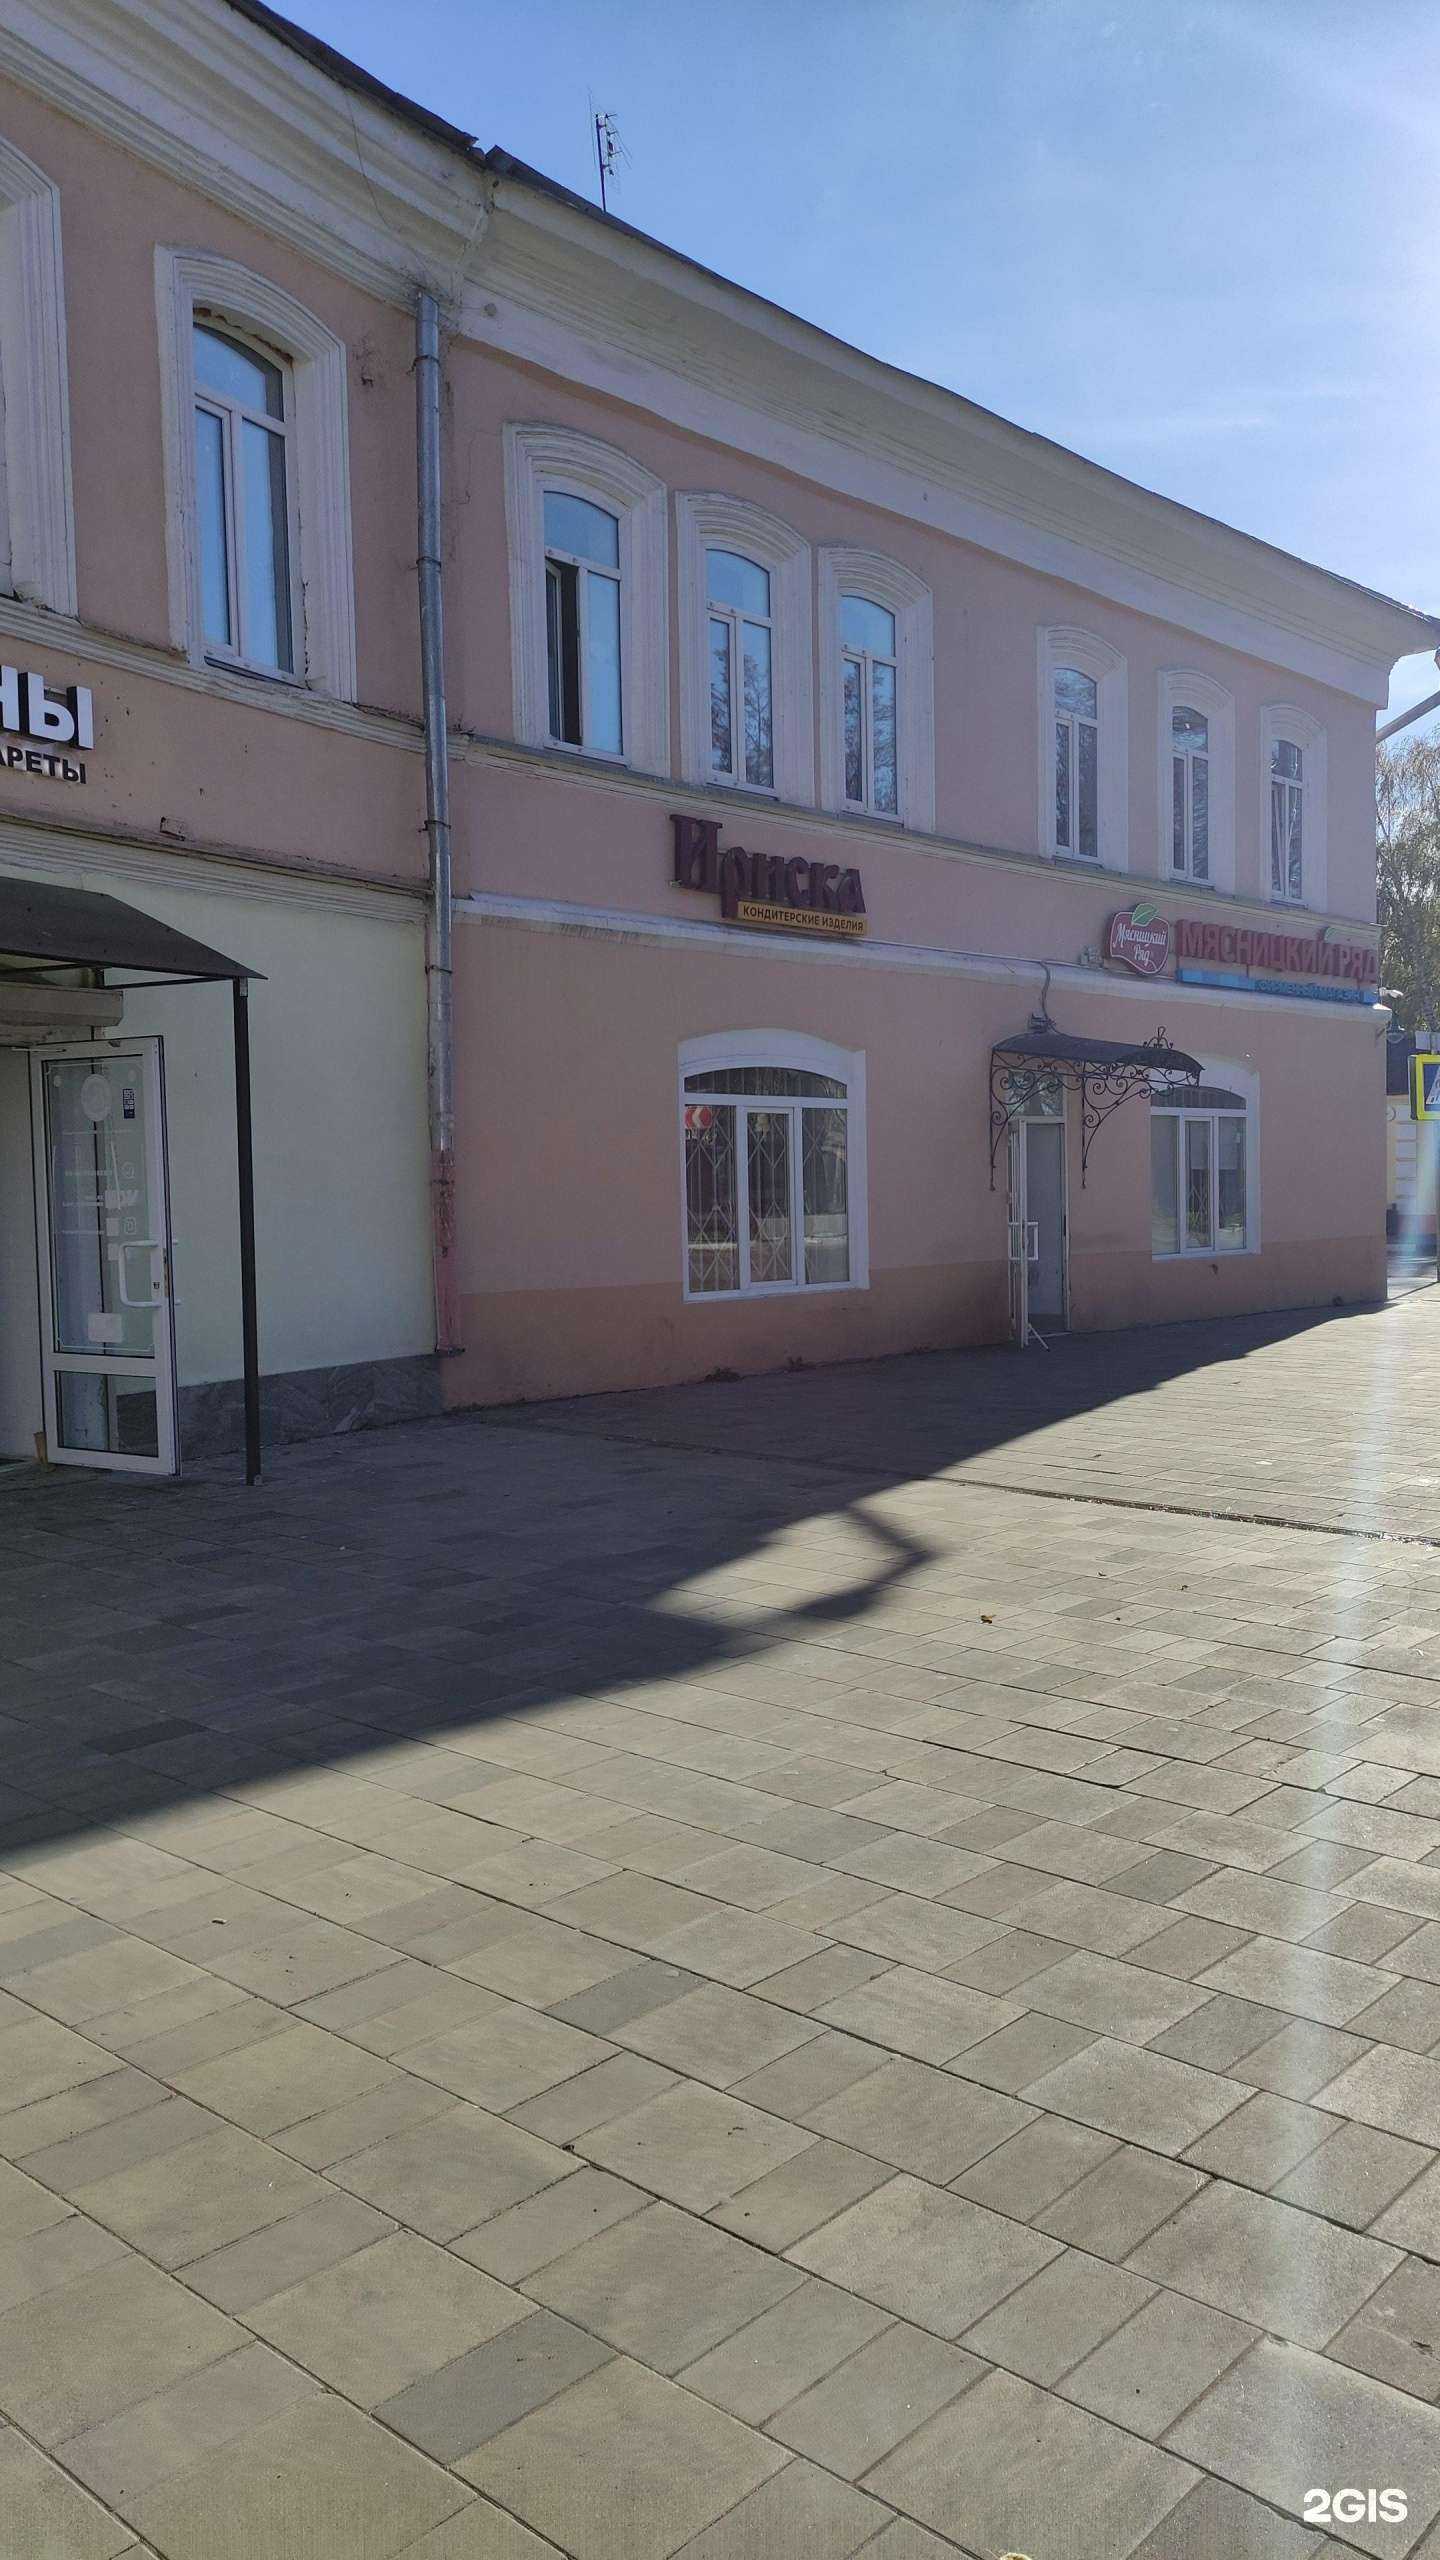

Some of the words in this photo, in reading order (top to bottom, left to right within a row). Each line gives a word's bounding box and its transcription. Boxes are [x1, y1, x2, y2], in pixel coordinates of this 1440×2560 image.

[743, 905, 819, 926] КОНДИТЕРСКИЕ
[822, 917, 864, 932] ИЗДЕЛИЯ
[1176, 919, 1334, 975] МЯСНИЦКИЙ
[1336, 943, 1377, 983] РЯД
